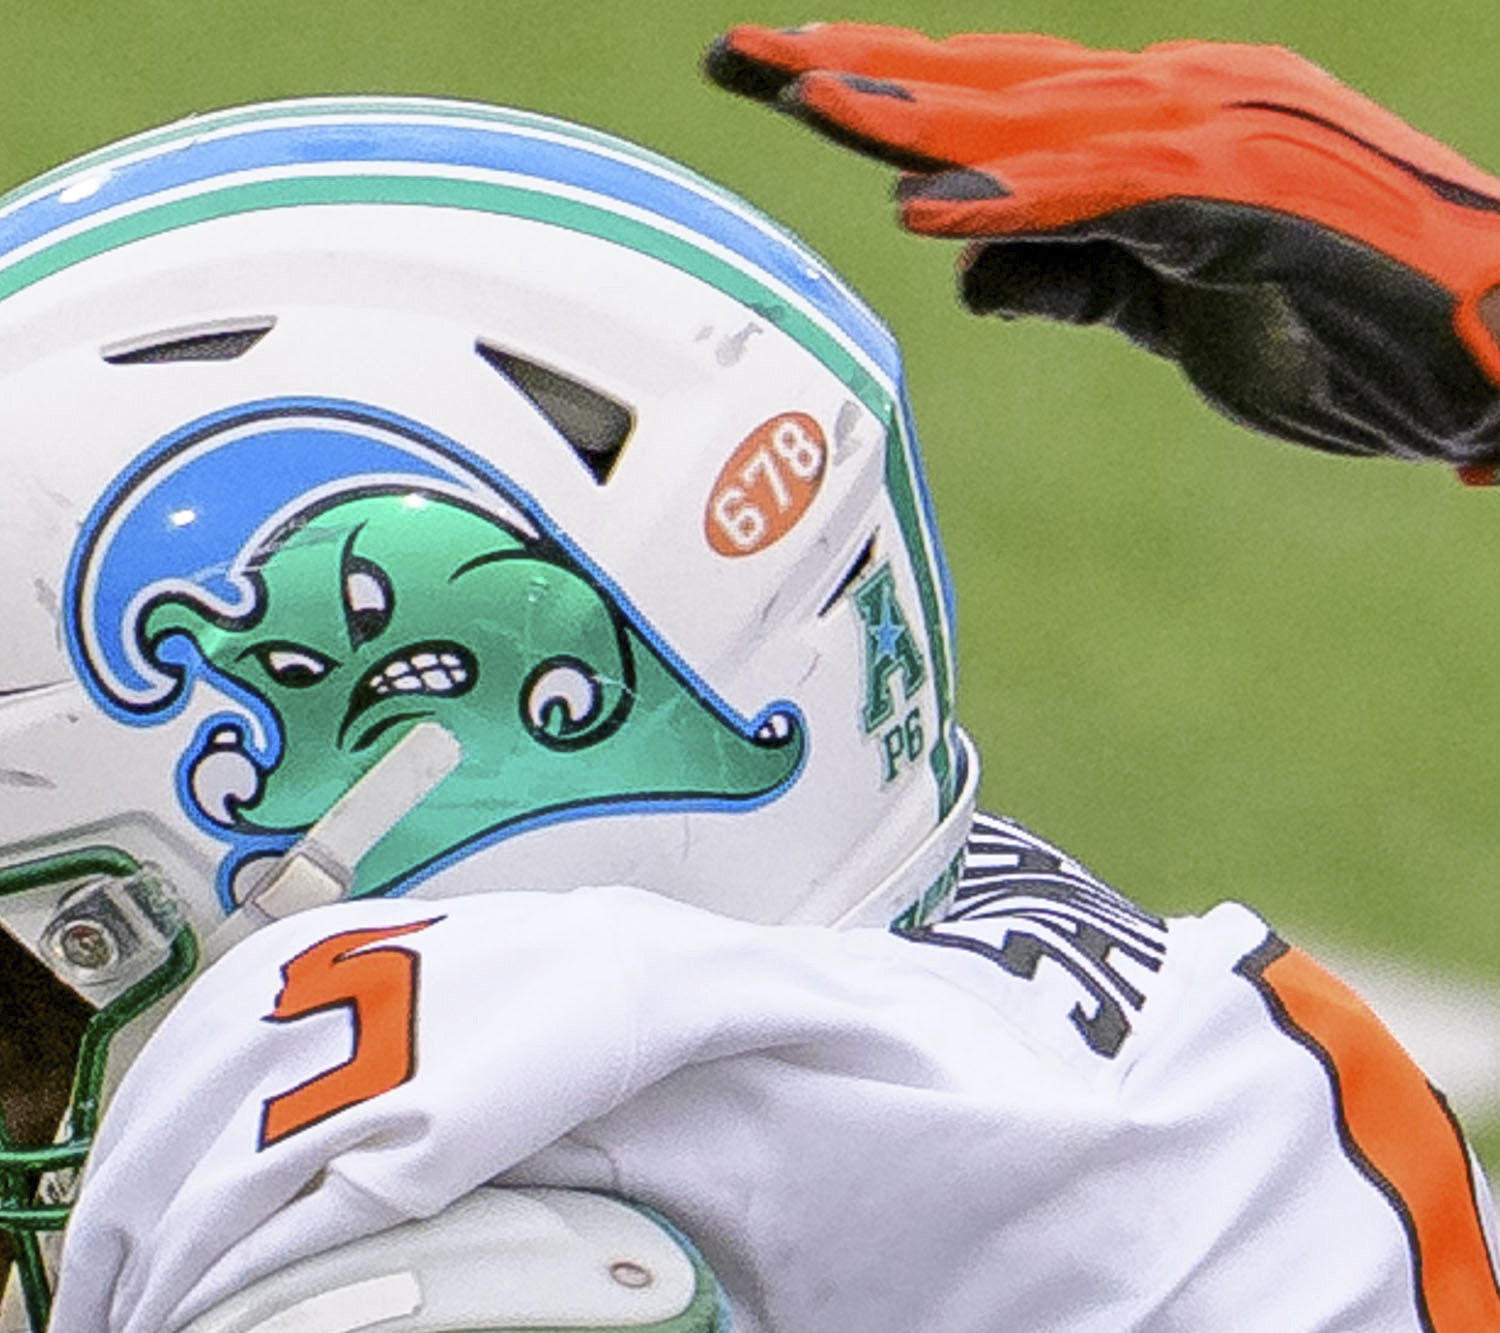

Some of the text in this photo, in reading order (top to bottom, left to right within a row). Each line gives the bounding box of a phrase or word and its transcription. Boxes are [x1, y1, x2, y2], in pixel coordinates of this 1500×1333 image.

[711, 418, 826, 549] 678
[883, 706, 925, 782] P6
[256, 914, 449, 1154] 5
